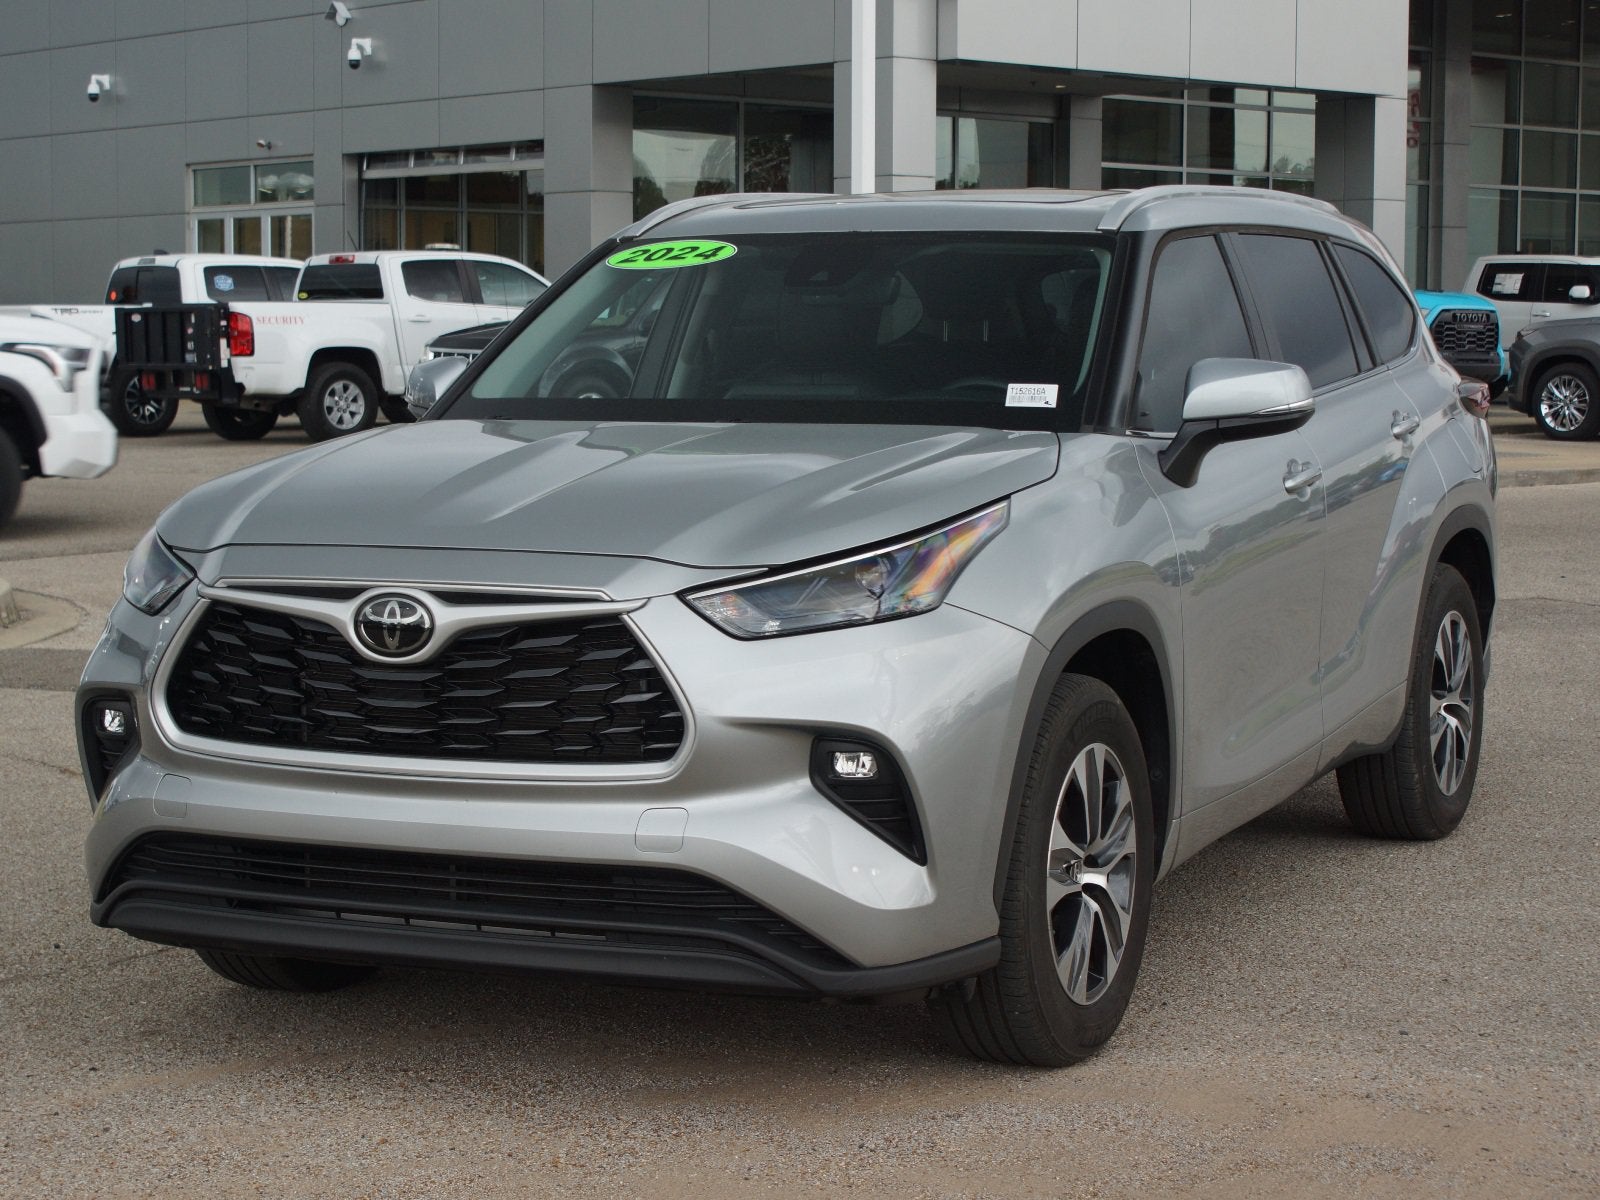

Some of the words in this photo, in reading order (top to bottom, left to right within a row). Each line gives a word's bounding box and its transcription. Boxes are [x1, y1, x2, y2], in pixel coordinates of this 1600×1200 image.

[615, 245, 728, 265] 2024
[256, 315, 305, 325] SECURITY
[1455, 313, 1488, 322] TOYOTA
